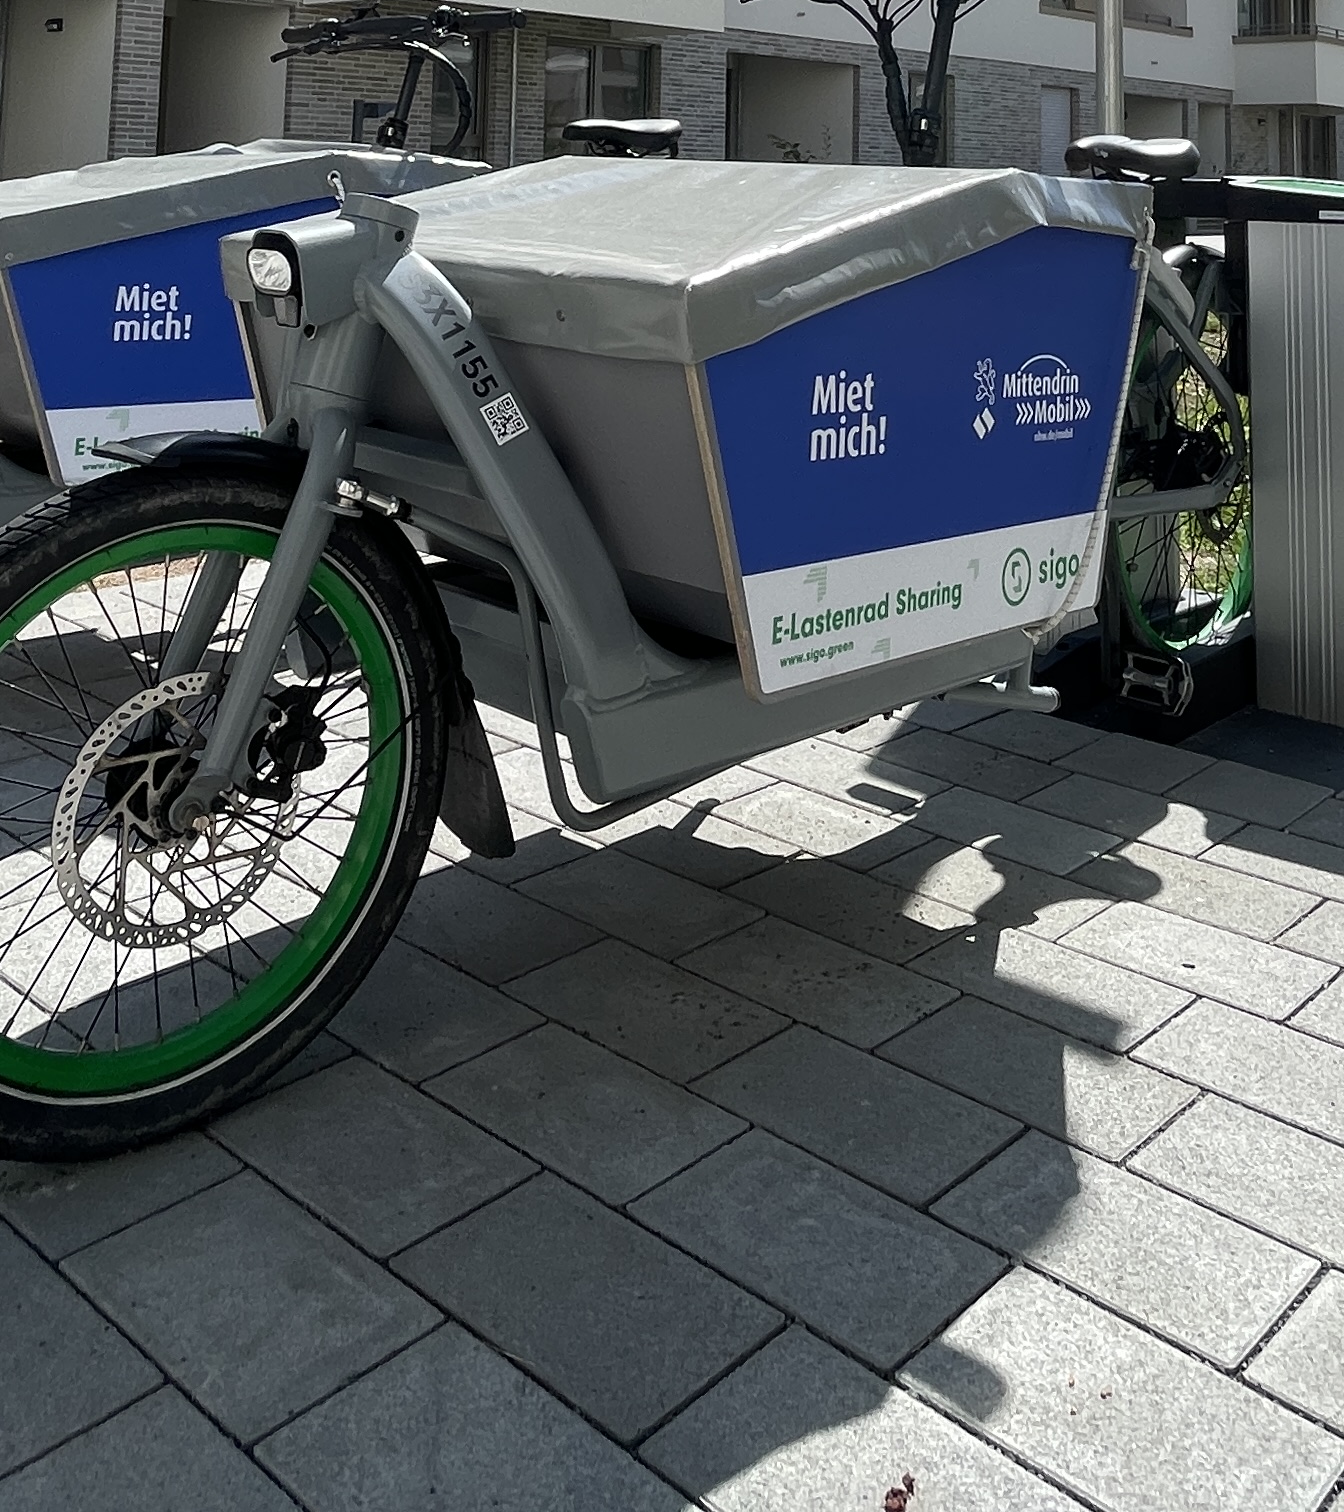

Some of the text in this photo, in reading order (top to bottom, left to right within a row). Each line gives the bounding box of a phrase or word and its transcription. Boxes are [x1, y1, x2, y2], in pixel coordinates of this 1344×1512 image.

[115, 283, 179, 311] Miet
[113, 311, 192, 342] mich!
[811, 370, 875, 416] Miet
[1002, 367, 1079, 399] Mittendrin
[810, 412, 887, 462] mich!
[1038, 547, 1080, 590] sigo
[771, 580, 963, 646] E-Lastenrad Sharing
[779, 640, 855, 668] www.sigo.green
